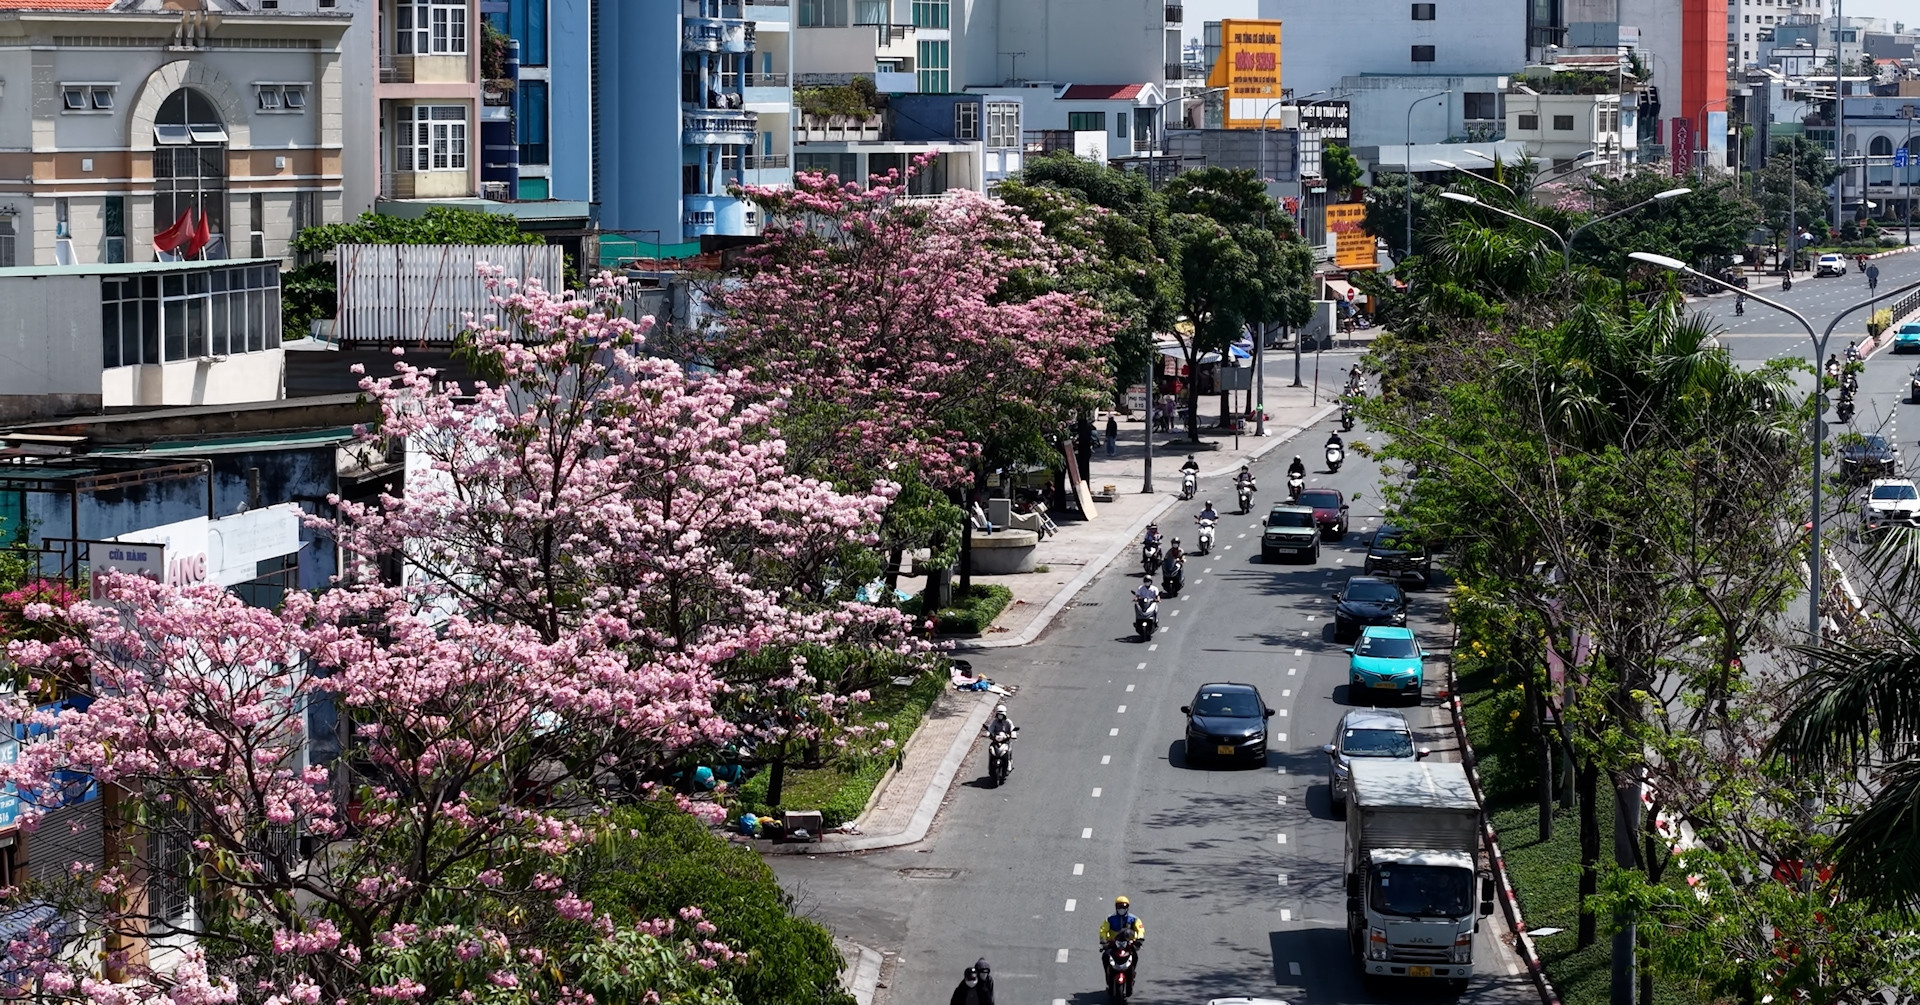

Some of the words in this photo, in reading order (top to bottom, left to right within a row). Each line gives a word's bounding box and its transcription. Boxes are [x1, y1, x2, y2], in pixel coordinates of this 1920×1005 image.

[1323, 102, 1336, 118] THỦY
[1337, 104, 1348, 120] LỰC
[109, 548, 124, 560] CỬA
[126, 549, 147, 561] HÀNG
[168, 551, 207, 588] ÁNG
[1, 745, 13, 762] XE
